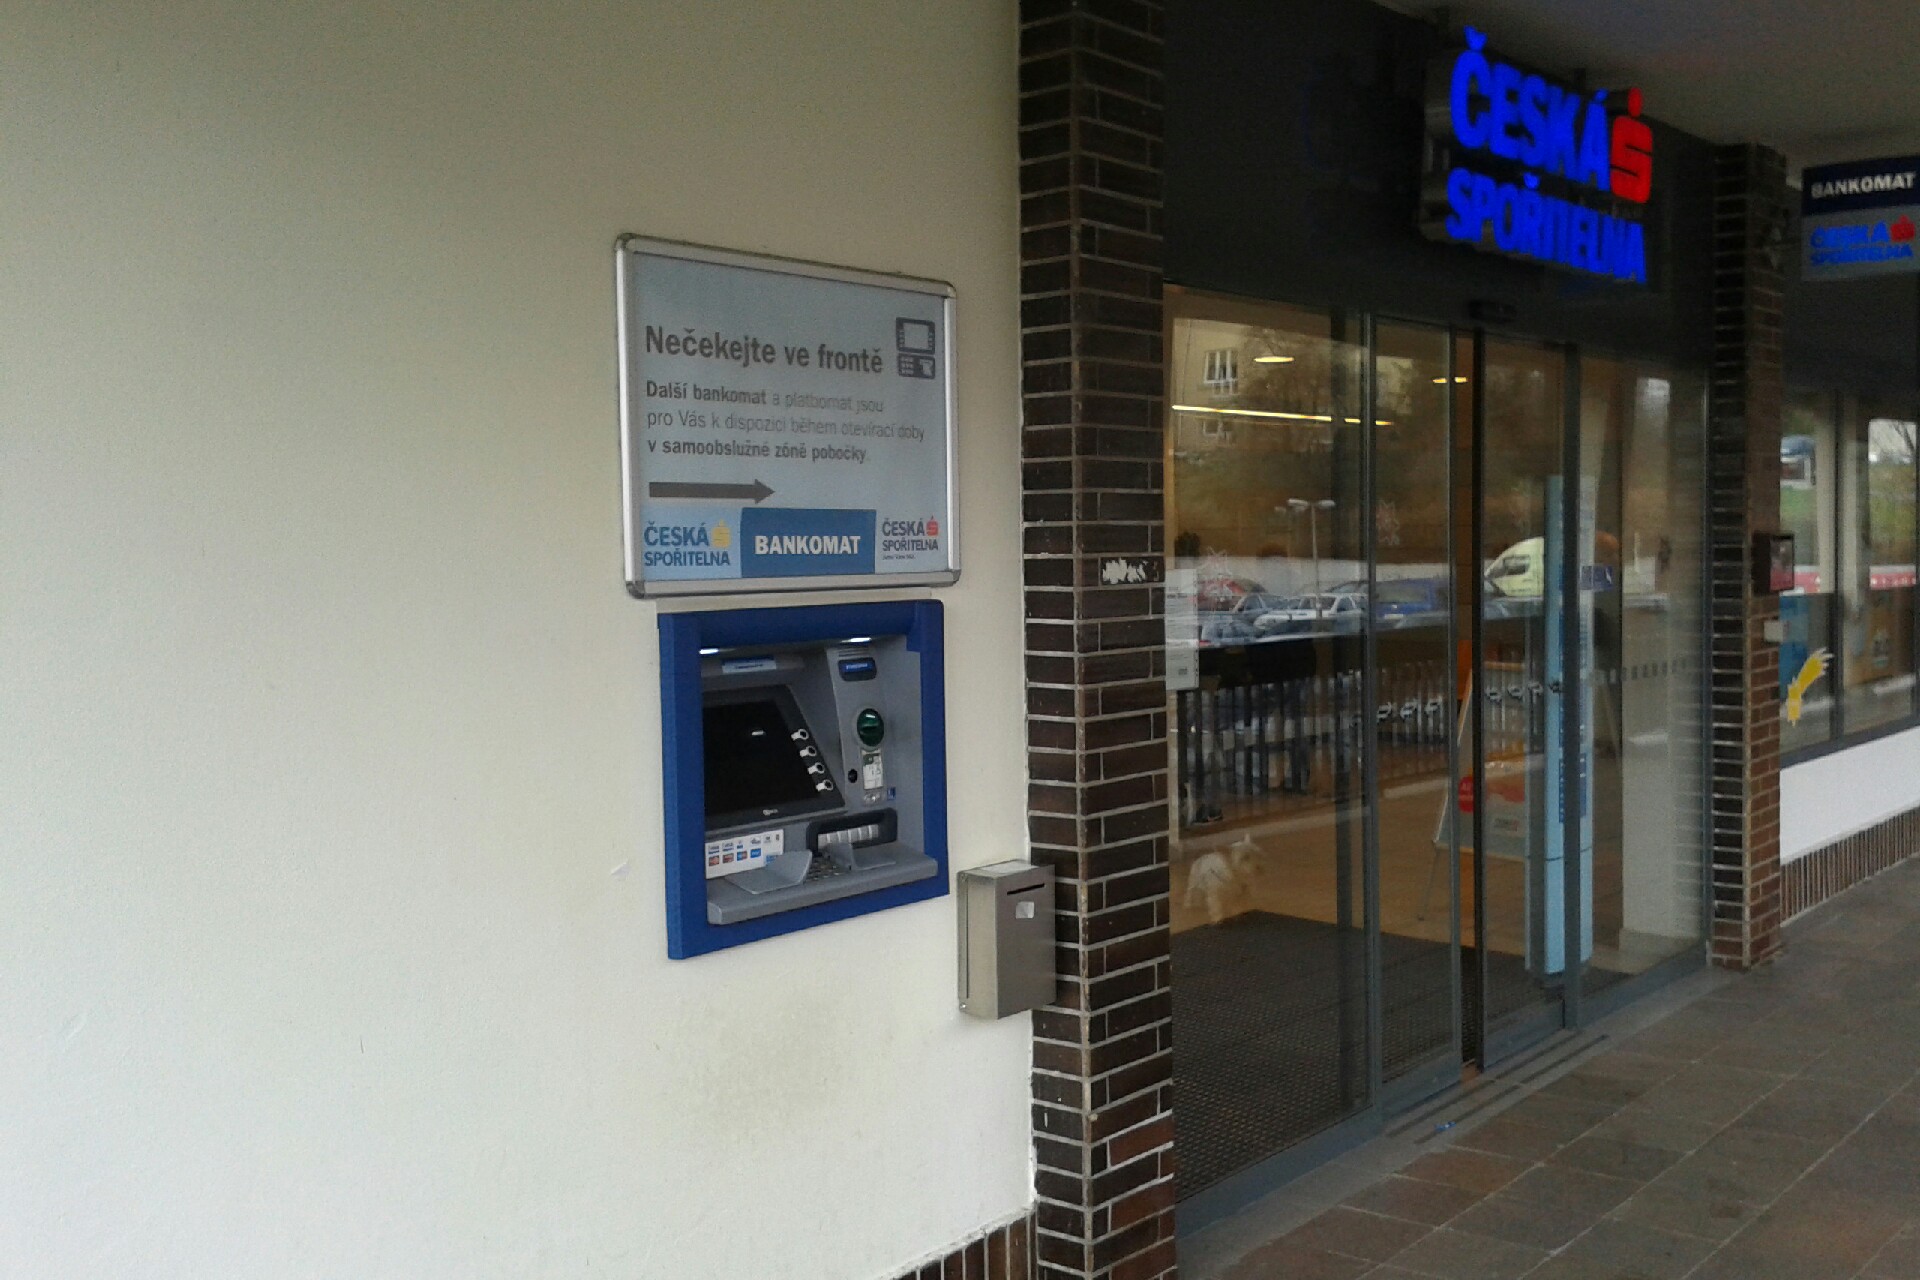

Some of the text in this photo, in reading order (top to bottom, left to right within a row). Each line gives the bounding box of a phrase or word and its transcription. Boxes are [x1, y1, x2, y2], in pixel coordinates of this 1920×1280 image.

[1450, 25, 1611, 192] ČESKÁ
[1811, 171, 1916, 199] BANKOMAT
[1446, 167, 1647, 284] SPOŘITELNA
[645, 325, 883, 374] Nečekejte ve frontě
[646, 380, 688, 399] Další
[693, 384, 767, 405] bankomat
[772, 393, 780, 406] a
[855, 399, 884, 415] jsou
[647, 412, 673, 429] pro
[678, 410, 706, 429] Vás
[711, 411, 720, 429] k
[791, 416, 837, 435] během
[898, 424, 925, 443] doby
[648, 440, 657, 453] v
[662, 439, 770, 457] samoobslužné
[775, 442, 807, 459] zóně
[644, 520, 710, 547] ČESKÁ
[882, 517, 925, 537] ČESKÁ
[644, 547, 731, 567] SPOŘITELNA
[754, 535, 861, 556] BANKOMAT
[882, 537, 939, 552] SPOŘITELNA
